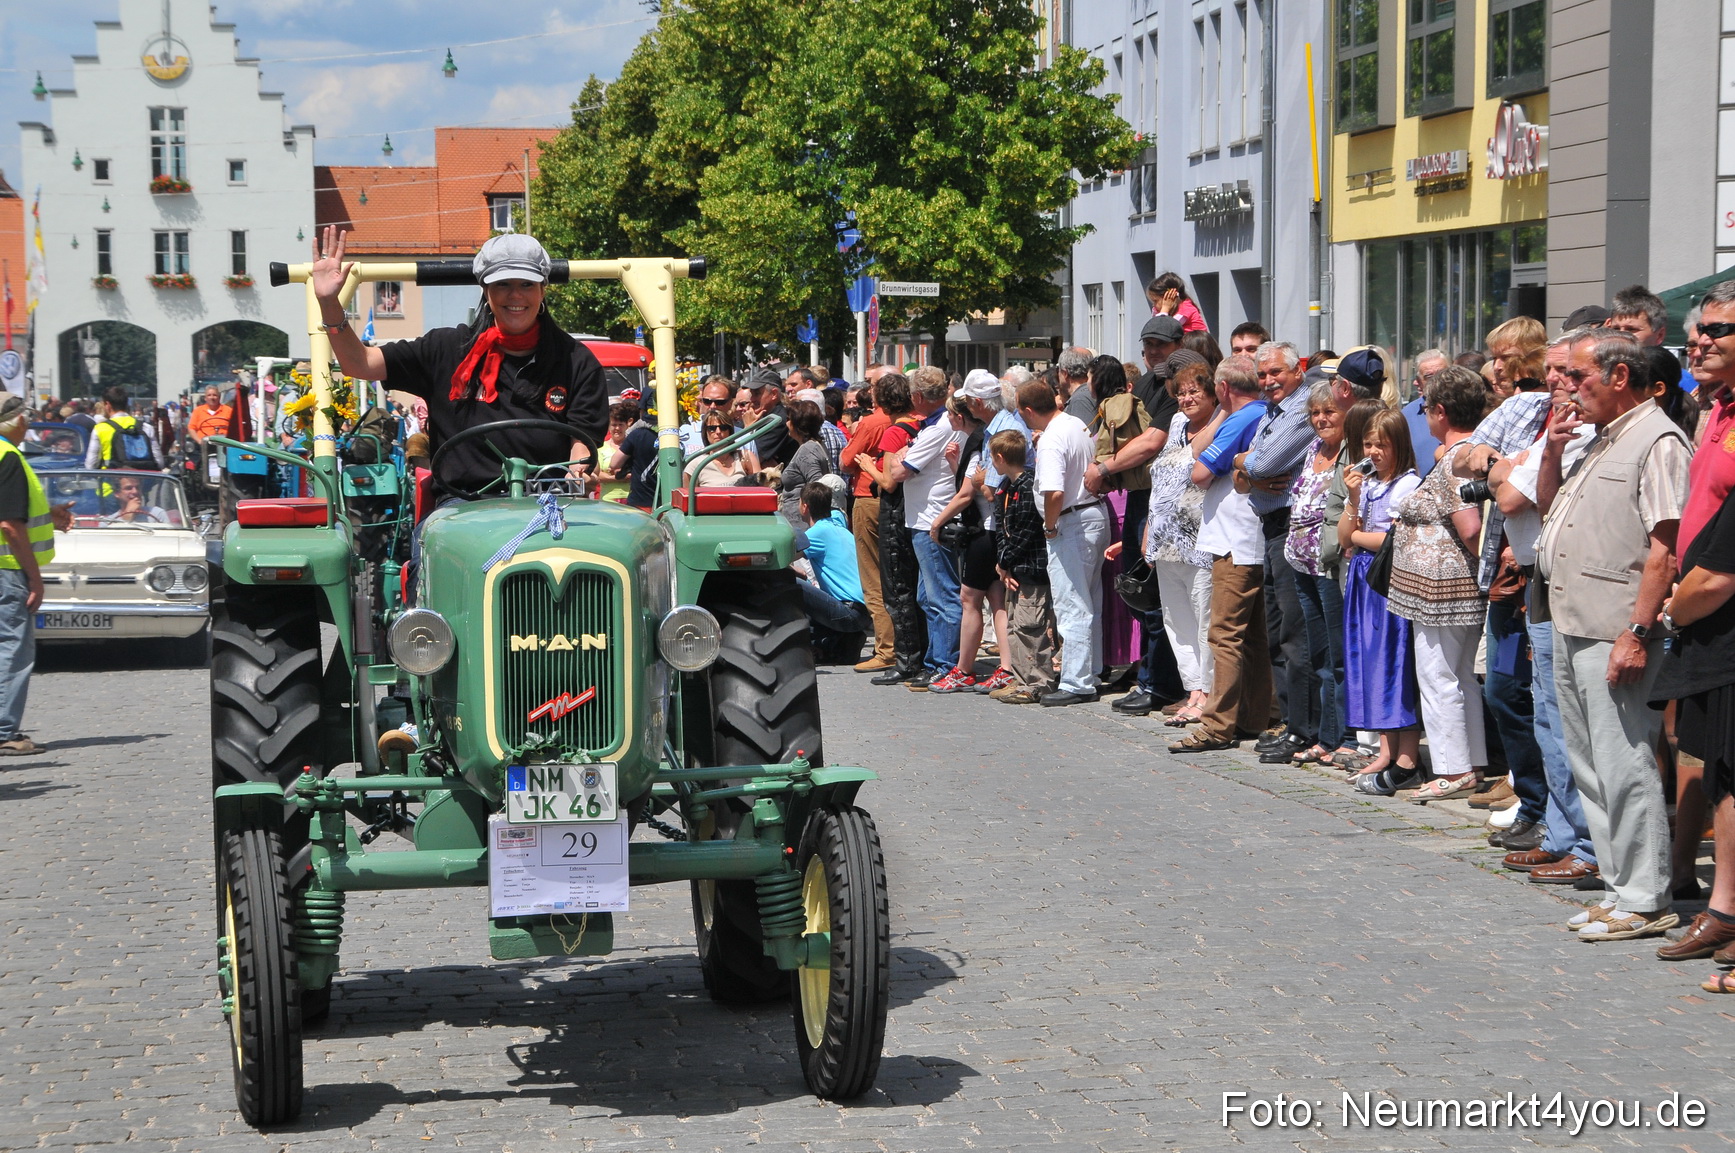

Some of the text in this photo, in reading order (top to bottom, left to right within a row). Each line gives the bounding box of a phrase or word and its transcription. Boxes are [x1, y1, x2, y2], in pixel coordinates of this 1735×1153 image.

[881, 283, 938, 295] Brunnwirtsgasse
[44, 613, 63, 627] RH
[513, 781, 521, 790] D
[529, 767, 564, 792] NM
[524, 793, 602, 819] JK 46
[561, 831, 598, 859] 29
